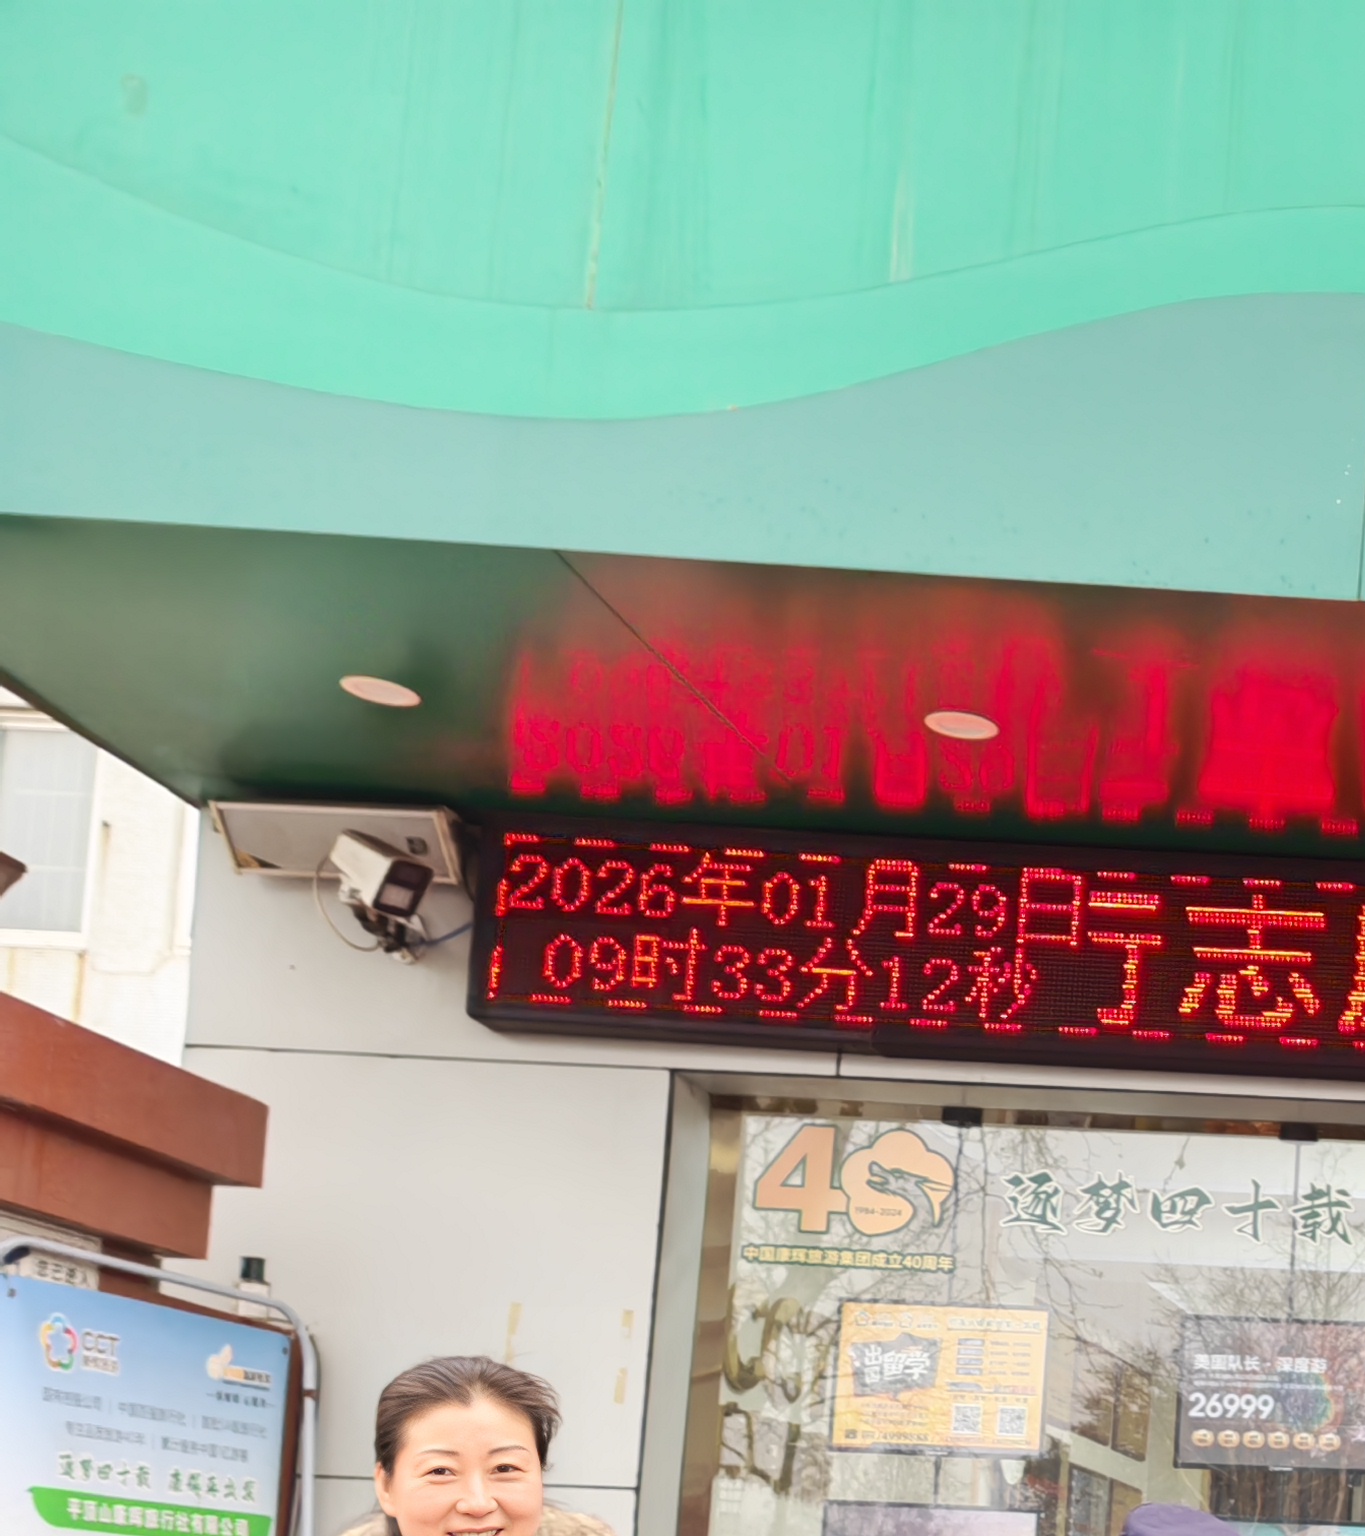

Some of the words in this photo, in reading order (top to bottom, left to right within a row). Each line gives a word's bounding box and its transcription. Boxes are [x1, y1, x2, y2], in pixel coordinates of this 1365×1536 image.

[508, 851, 1082, 949] 2026年01月29日
[541, 927, 1038, 1023] 09时33分12秒
[855, 1206, 903, 1217] 1984-2024
[1000, 1170, 1355, 1246] 逐梦四十载
[741, 1244, 956, 1272] 中国康辉旅游集团成立40周年
[82, 1330, 120, 1356] CCT
[1188, 1391, 1276, 1420] 26999
